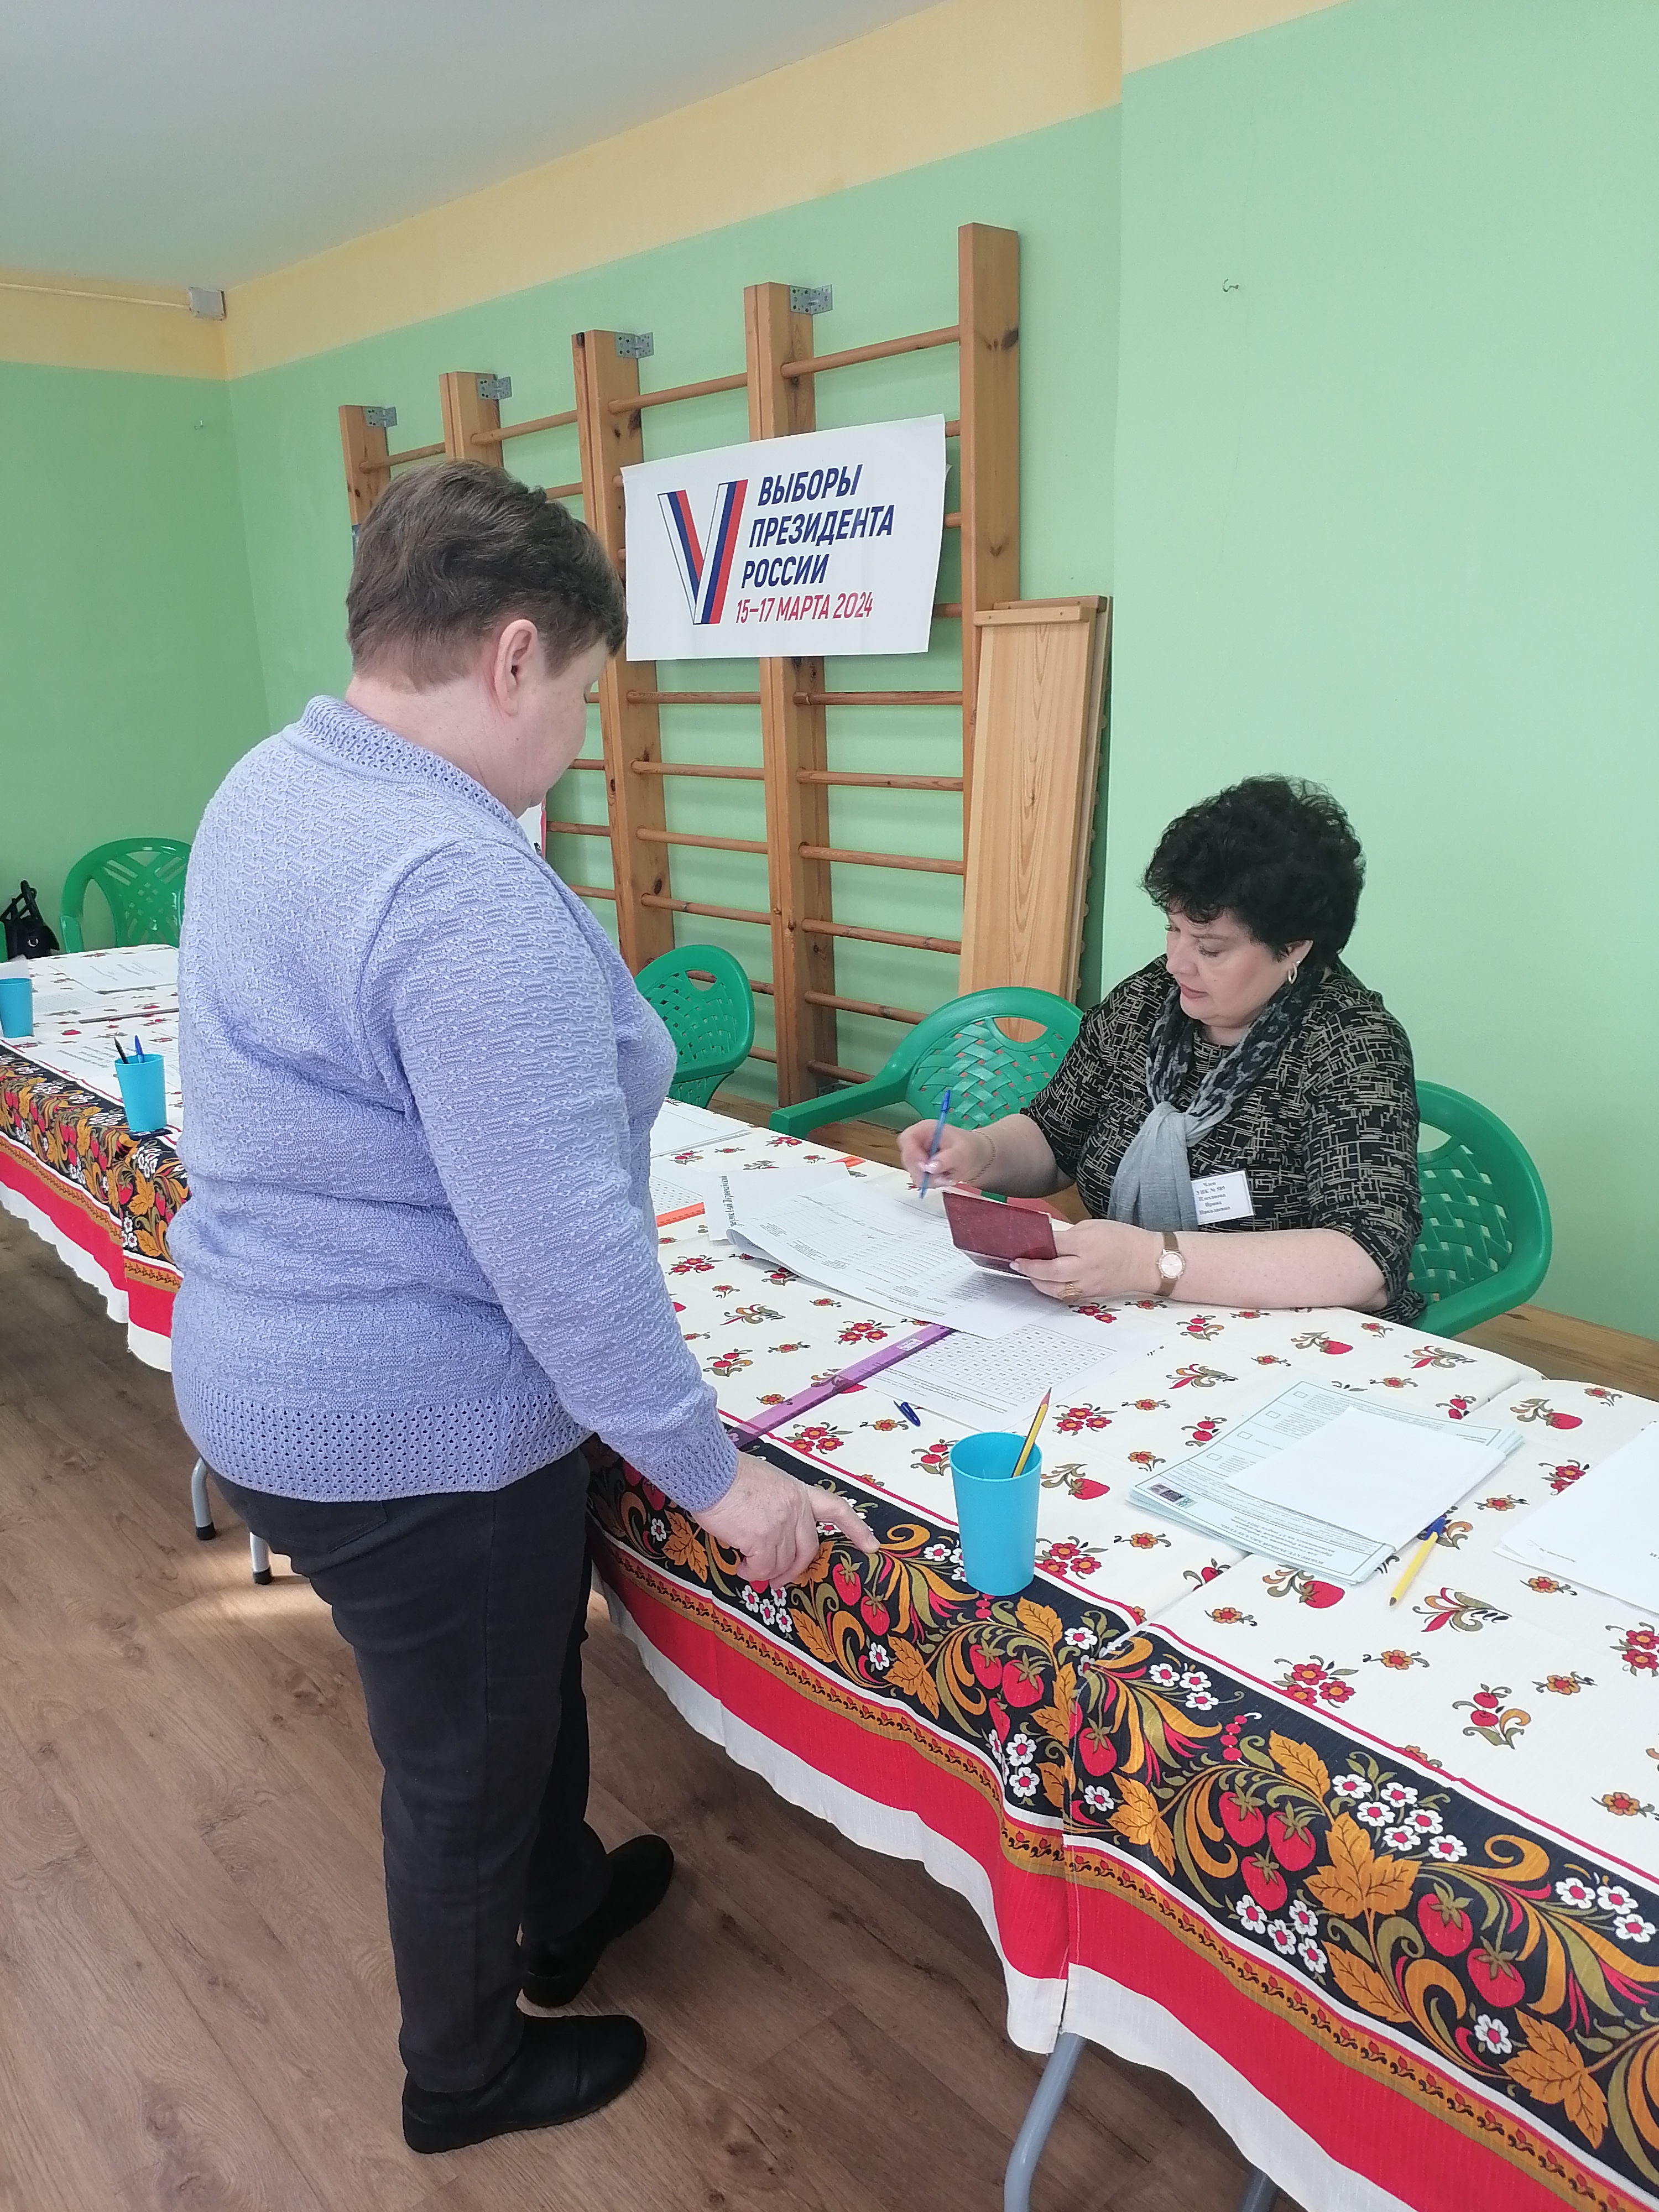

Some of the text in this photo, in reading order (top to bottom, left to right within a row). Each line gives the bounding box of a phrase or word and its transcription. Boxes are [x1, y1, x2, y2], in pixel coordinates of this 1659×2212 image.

[757, 464, 863, 507] ВЫБОРЫ
[749, 504, 895, 548] ПРЕЗИДЕНТА
[741, 554, 830, 589] РОССИИ
[776, 594, 830, 622] МАРТА
[833, 591, 873, 619] 2024
